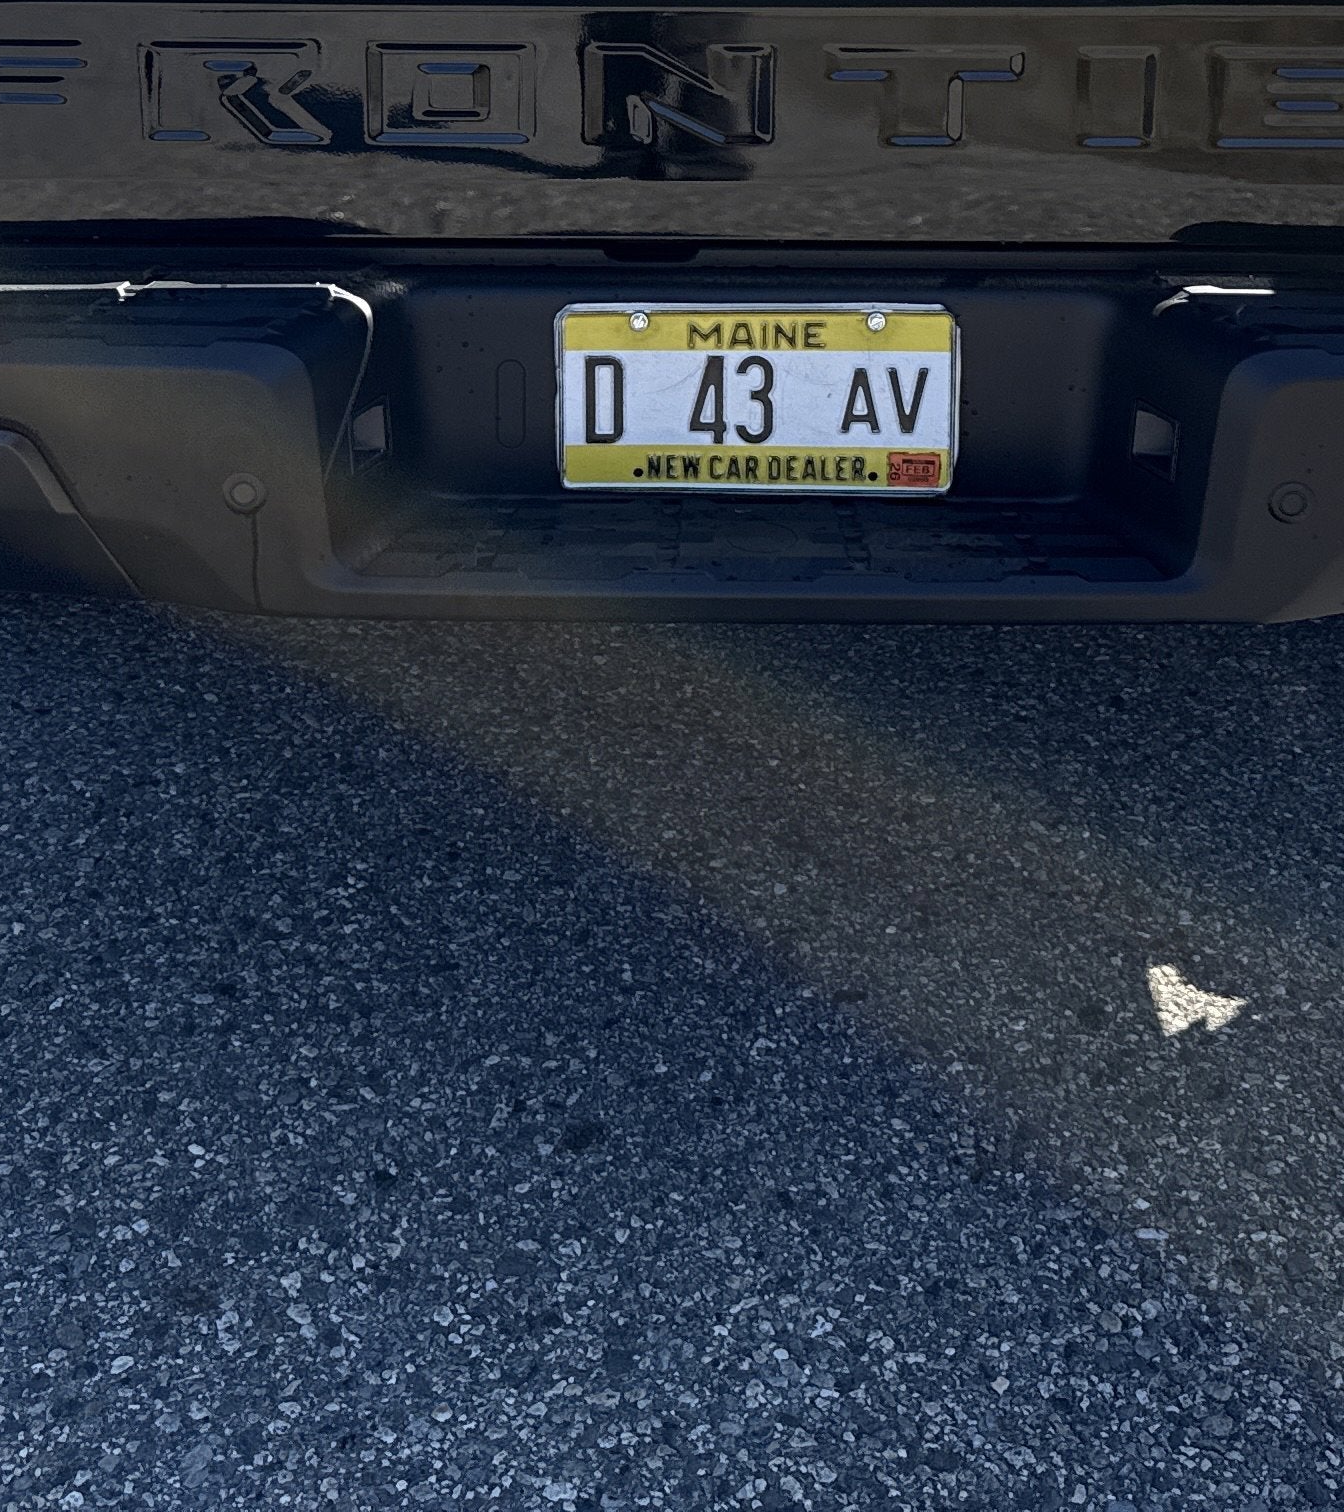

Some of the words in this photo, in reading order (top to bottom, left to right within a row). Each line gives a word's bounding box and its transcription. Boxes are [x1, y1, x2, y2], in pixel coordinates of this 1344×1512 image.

[687, 321, 828, 349] MAINE
[584, 354, 624, 444] D
[689, 354, 775, 444] 43
[839, 367, 929, 434] AV
[647, 454, 701, 479] NEW
[709, 455, 759, 480] CAR
[768, 455, 866, 481] DEALER
[905, 465, 930, 474] FEB
